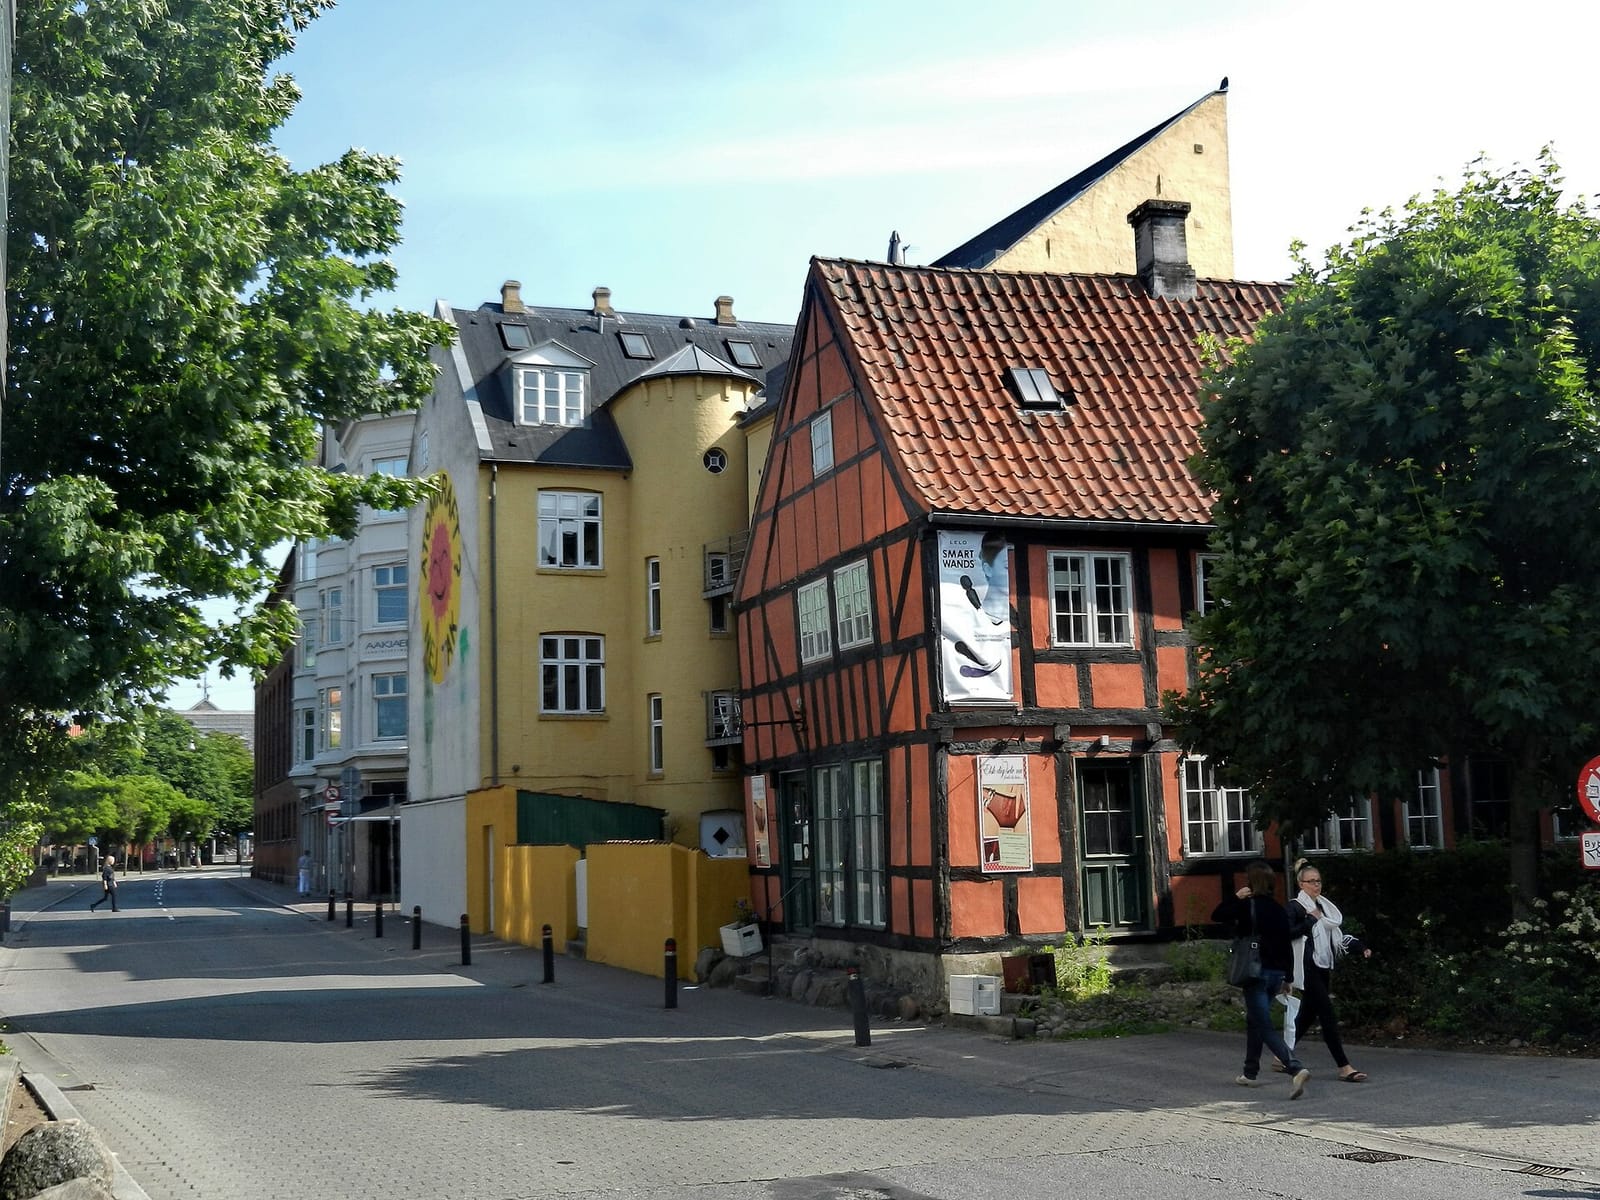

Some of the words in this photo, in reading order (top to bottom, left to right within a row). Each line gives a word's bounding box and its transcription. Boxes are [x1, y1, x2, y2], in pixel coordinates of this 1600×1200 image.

[942, 549, 974, 559] SMART
[942, 559, 975, 569] WANDS
[366, 640, 409, 649] AAKJAE
